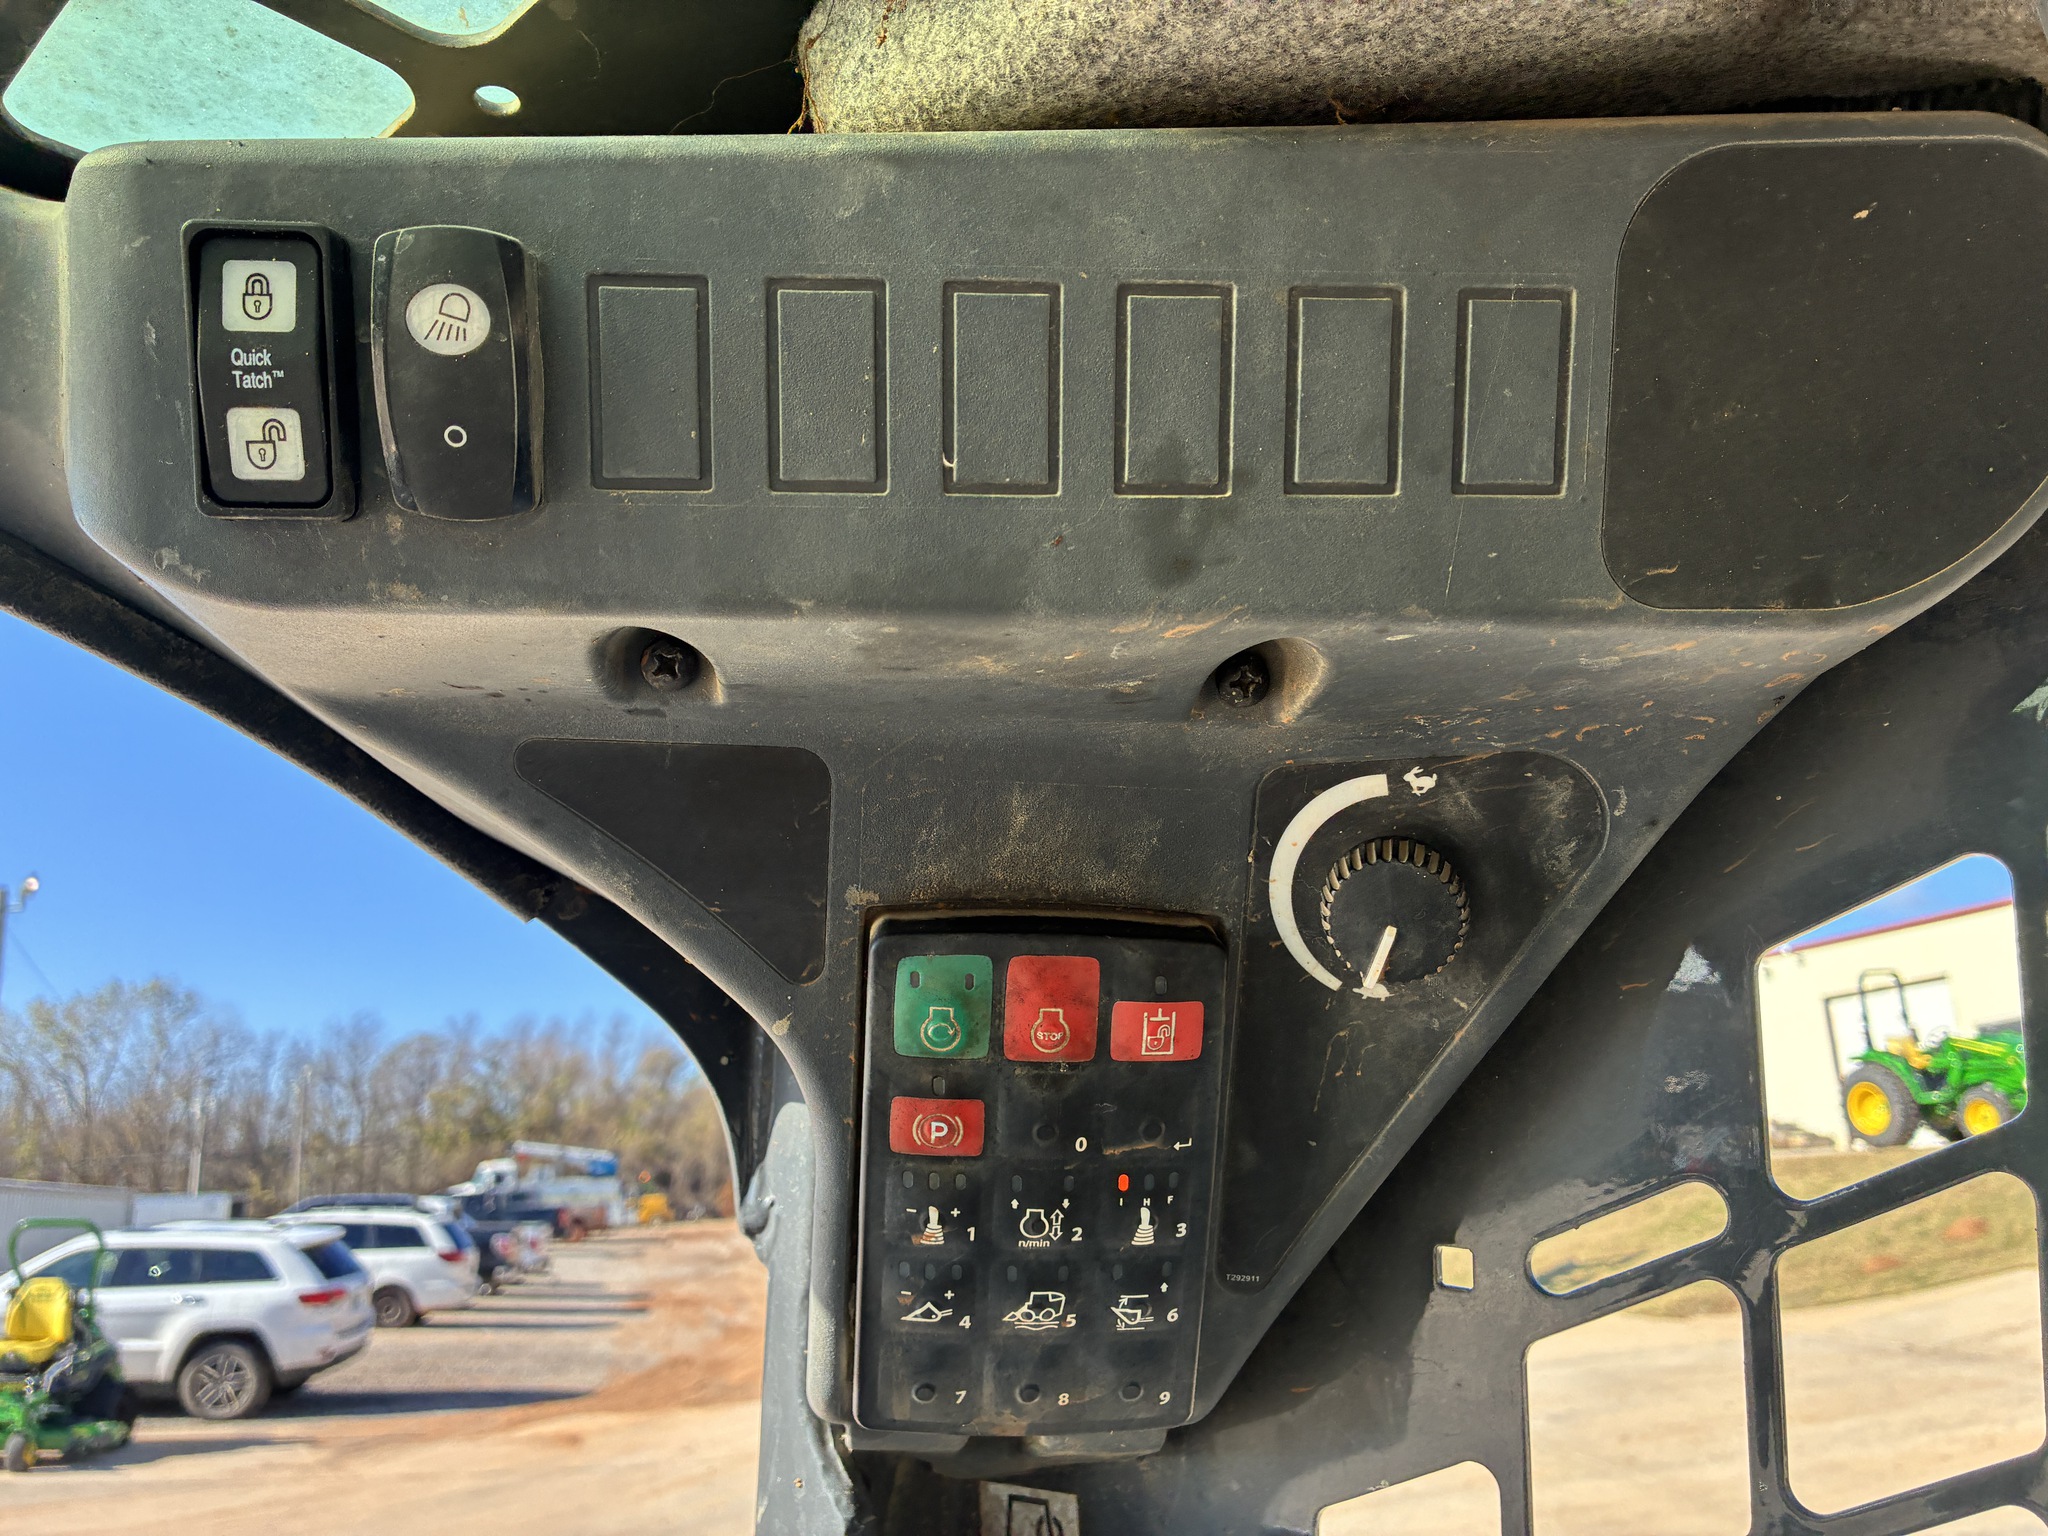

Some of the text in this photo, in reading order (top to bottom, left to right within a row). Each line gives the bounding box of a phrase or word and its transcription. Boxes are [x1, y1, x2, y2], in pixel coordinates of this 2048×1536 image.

[230, 348, 273, 367] Quick
[1036, 1031, 1064, 1042] STOP
[930, 1121, 949, 1144] P
[1143, 1198, 1151, 1206] H
[1167, 1195, 1174, 1205] F
[966, 1226, 976, 1242] 1
[1071, 1227, 1083, 1241] 2
[1175, 1223, 1188, 1238] 3
[1018, 1237, 1050, 1248] n/min
[1226, 1273, 1260, 1282] T292911
[958, 1315, 971, 1329] 4
[1065, 1313, 1077, 1327] 5
[1166, 1308, 1179, 1322] 6
[955, 1390, 967, 1404] 7
[1057, 1393, 1070, 1406] 8
[1159, 1391, 1171, 1405] 9
